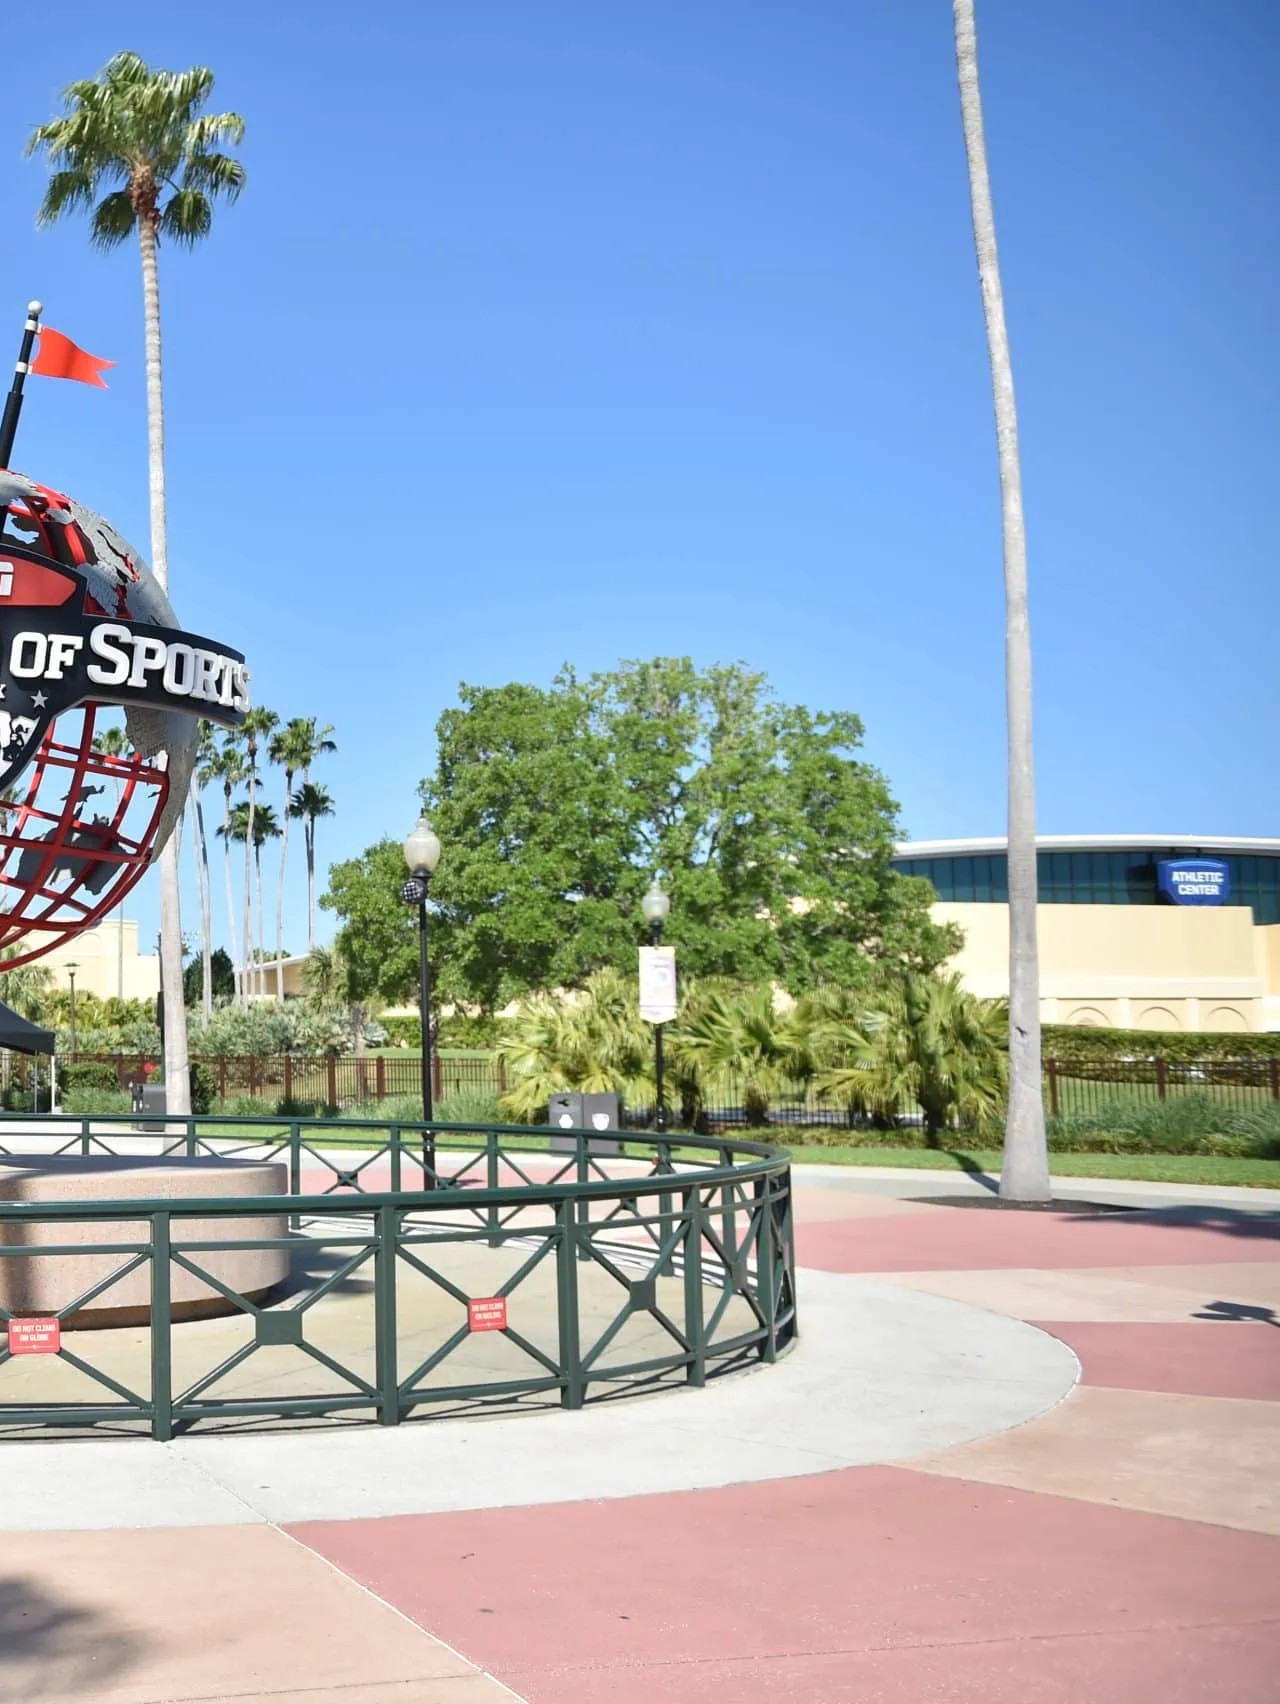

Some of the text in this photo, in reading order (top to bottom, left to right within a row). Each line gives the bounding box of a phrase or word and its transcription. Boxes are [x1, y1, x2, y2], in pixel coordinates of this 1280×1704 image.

[9, 632, 83, 679] OF
[86, 623, 252, 713] SPORTS
[1172, 871, 1225, 883] ATHLETIC
[1178, 884, 1221, 896] CENTER
